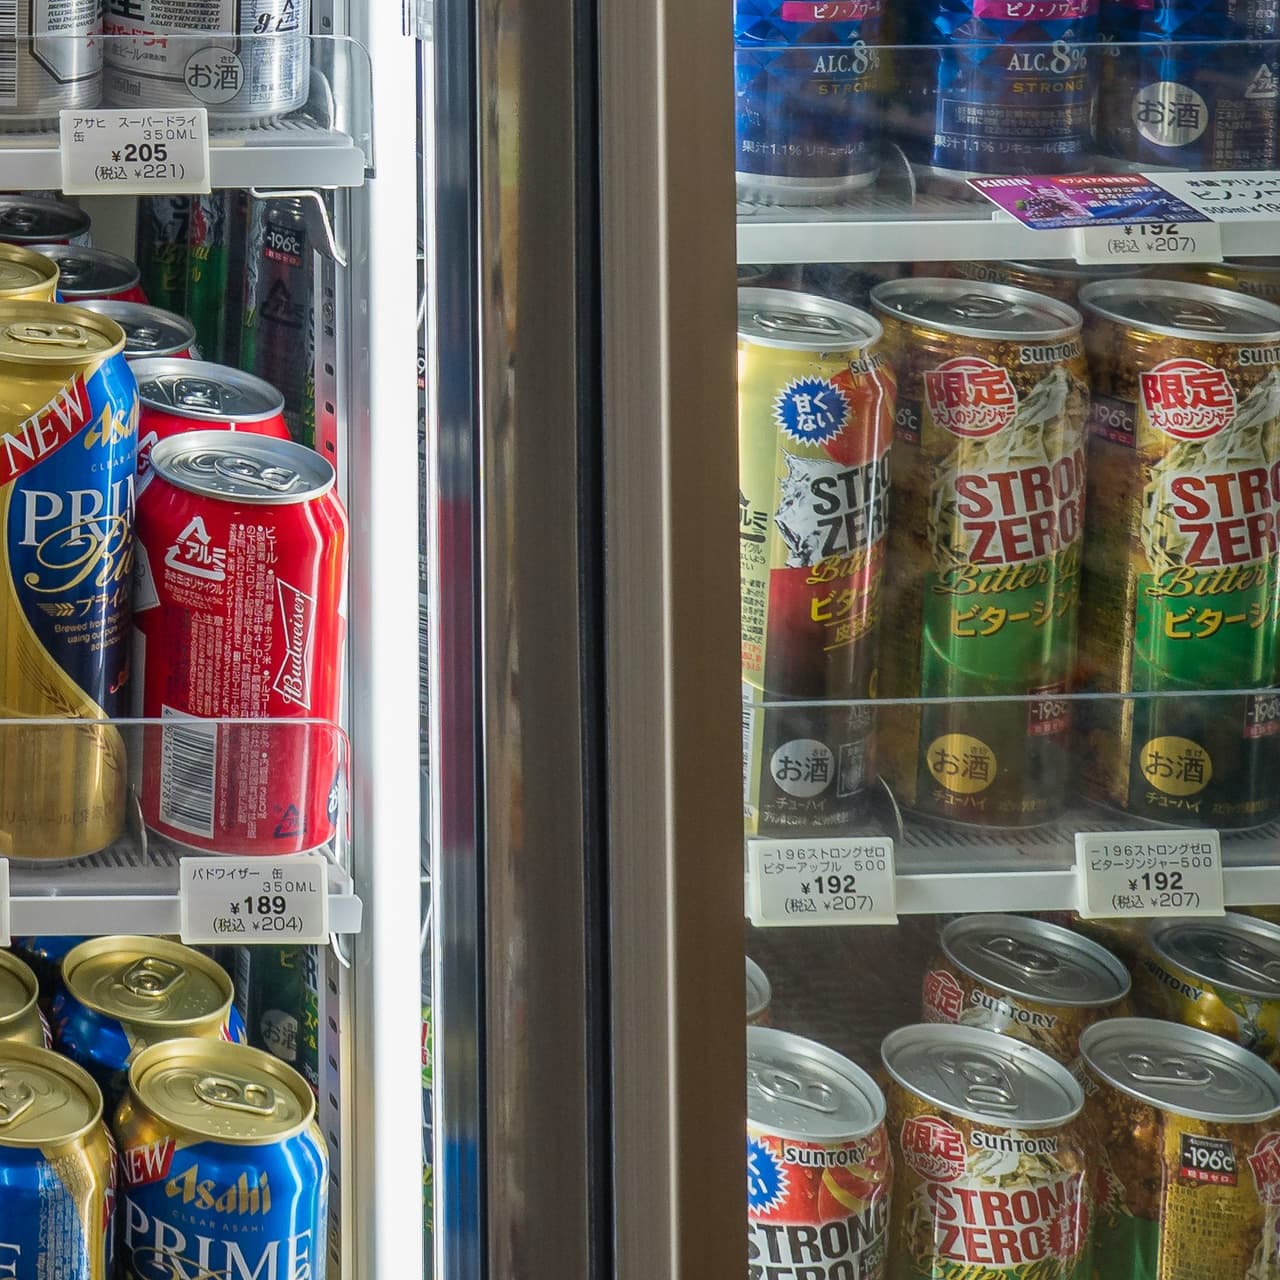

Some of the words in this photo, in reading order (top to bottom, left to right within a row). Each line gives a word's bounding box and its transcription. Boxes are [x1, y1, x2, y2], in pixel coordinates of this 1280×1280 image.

[188, 64, 240, 90] お酒
[1013, 80, 1083, 92] STRONG
[112, 144, 167, 162] ¥205
[135, 164, 184, 179] ¥221)
[1146, 237, 1195, 252] ¥207)
[926, 369, 1012, 408] 限定
[791, 394, 828, 410] 甘く
[4, 375, 89, 477] NEW
[796, 414, 833, 429] ない
[283, 588, 314, 706] Budweiser
[263, 881, 316, 893] 350ML
[801, 875, 856, 894] ¥192
[1129, 872, 1183, 891] ¥192
[230, 896, 286, 914] ¥189
[970, 991, 1057, 1027] SUNTORY
[970, 1132, 1057, 1154] SUNTORY
[785, 1147, 866, 1166] SUNTORY
[165, 1163, 270, 1215] Asahi
[939, 1221, 1043, 1265] ZERO
